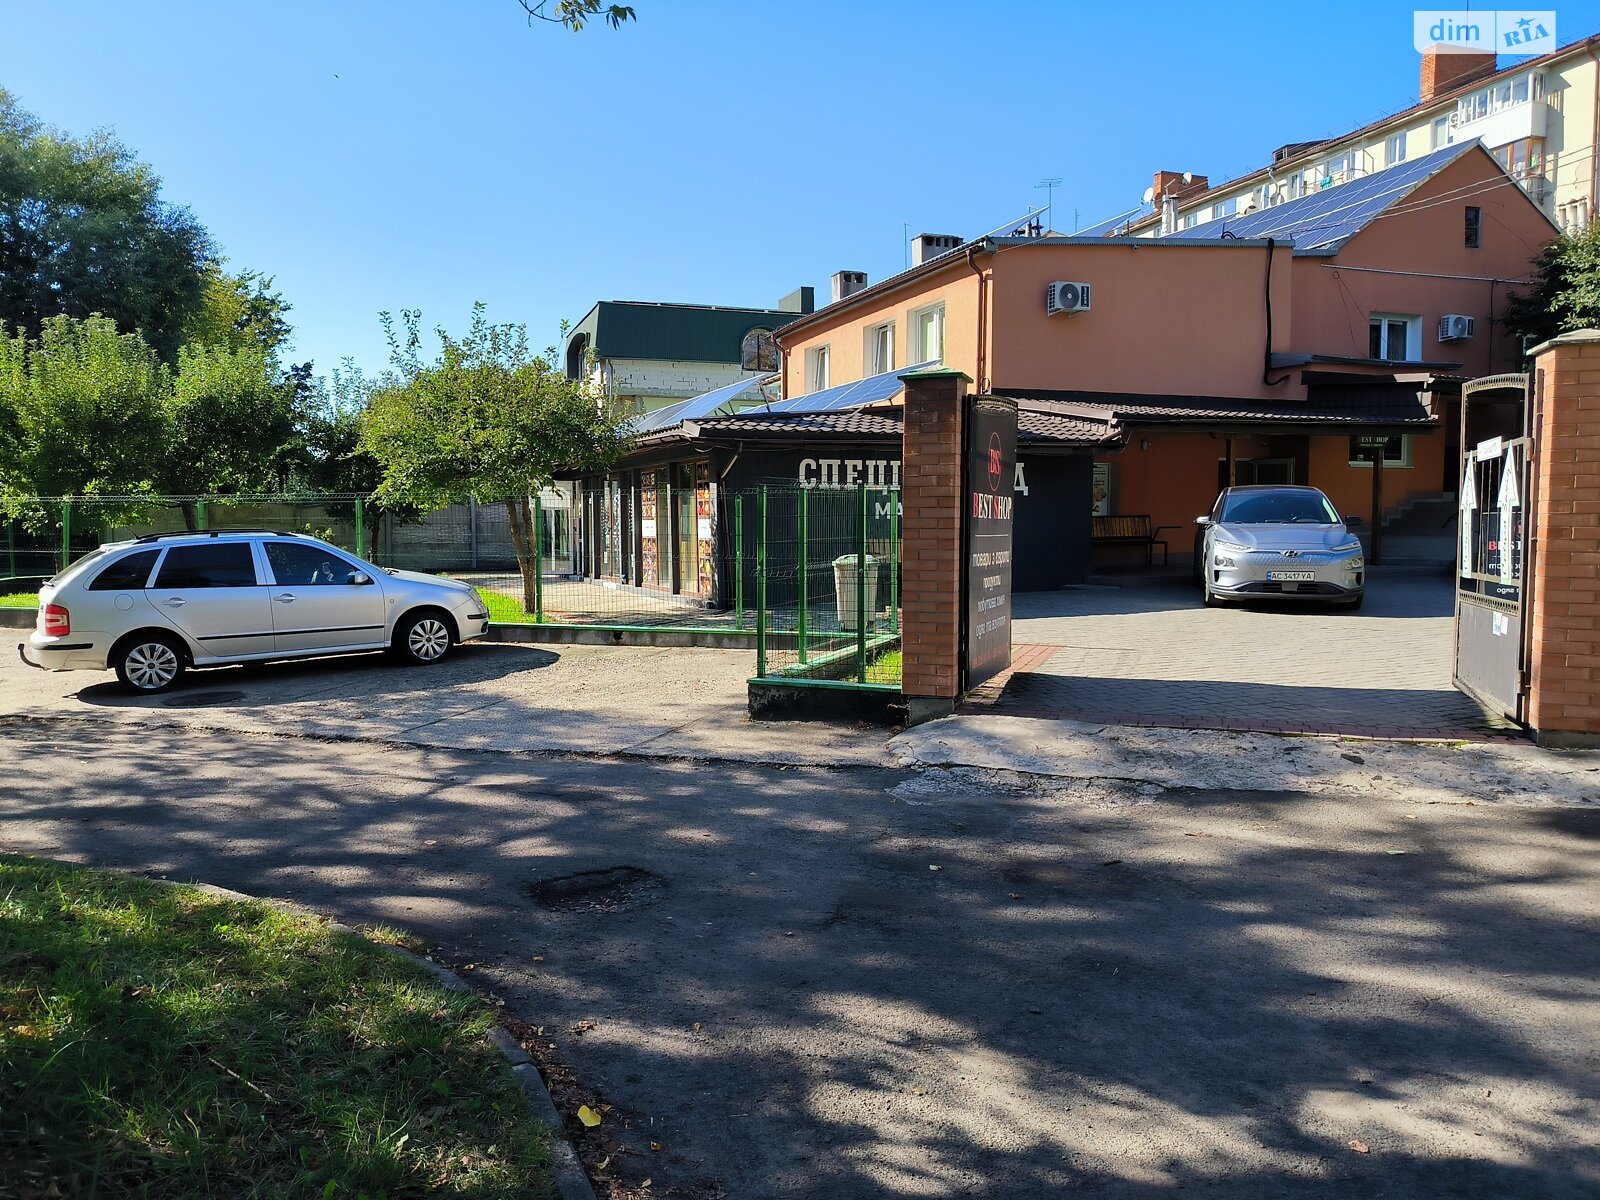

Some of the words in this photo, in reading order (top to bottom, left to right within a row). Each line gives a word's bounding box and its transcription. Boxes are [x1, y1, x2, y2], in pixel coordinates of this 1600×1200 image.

[972, 492, 993, 519] BEST
[993, 495, 1012, 520] SHOP
[1272, 572, 1282, 580] AC
[1284, 572, 1300, 580] 3417
[1301, 572, 1311, 580] YA
